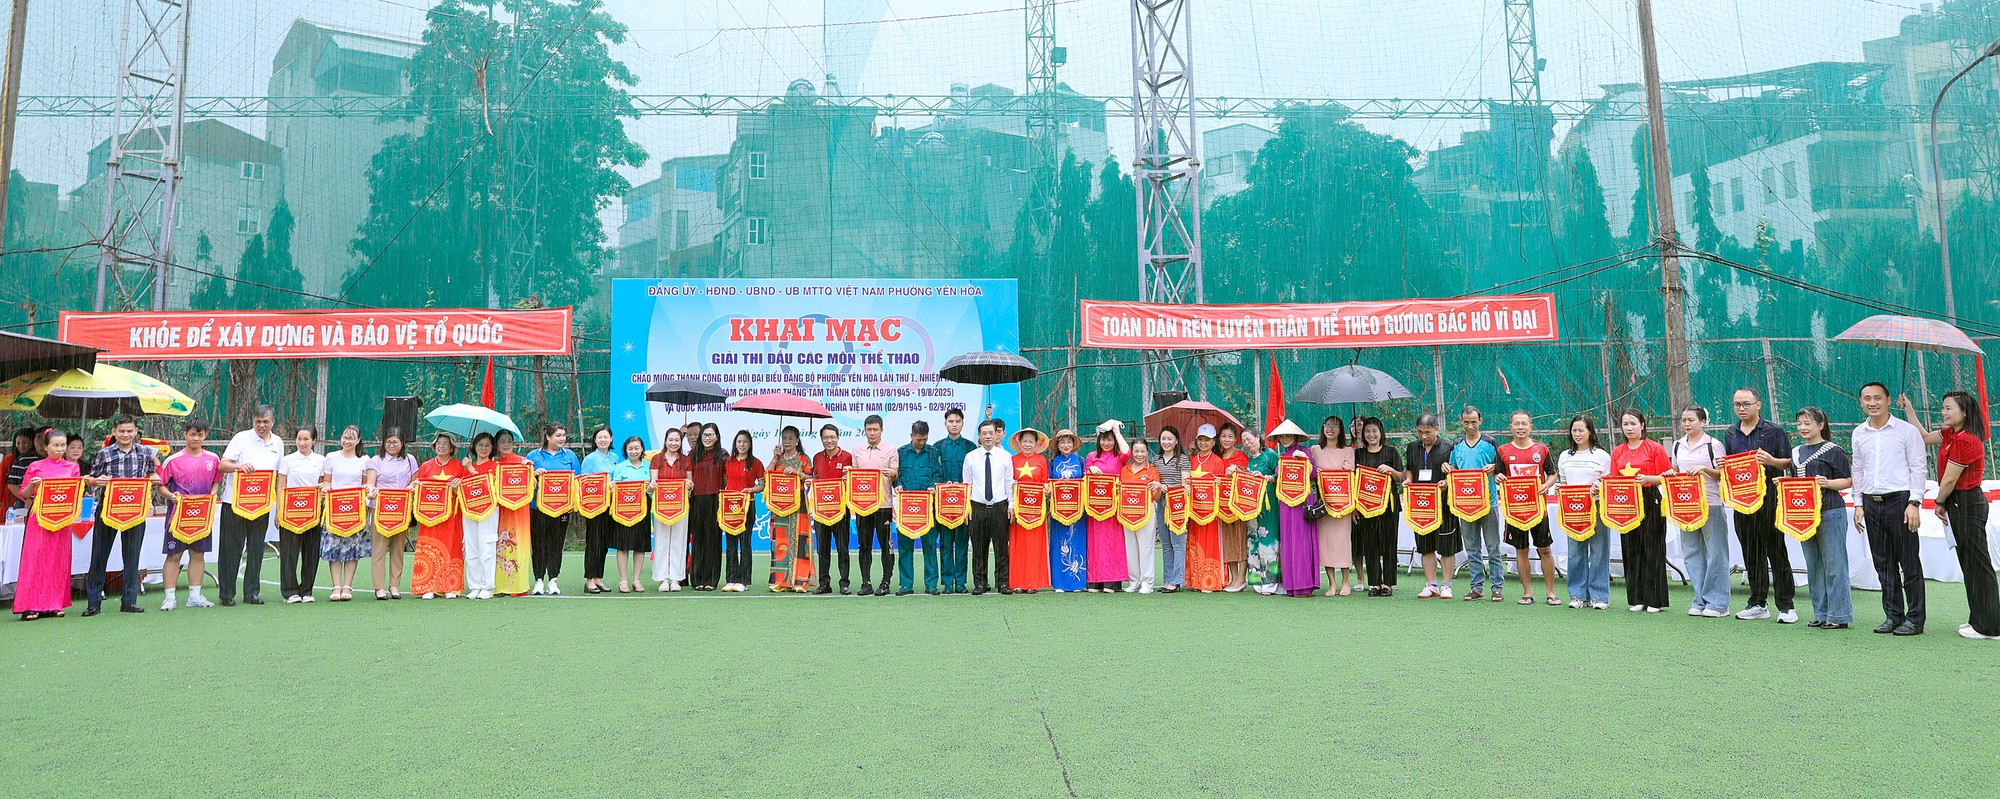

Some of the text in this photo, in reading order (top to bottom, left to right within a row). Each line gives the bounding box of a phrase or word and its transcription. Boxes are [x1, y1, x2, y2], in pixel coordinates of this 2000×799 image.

[648, 284, 678, 296] ĐẢNG
[682, 283, 696, 296] ỦY
[706, 286, 736, 296] HĐND
[746, 286, 776, 296] UBND
[786, 286, 800, 296] UB
[804, 286, 832, 296] MTTQ
[836, 285, 858, 297] VIỆT
[862, 286, 884, 296] NAM
[888, 284, 932, 296] PHƯỜNG
[936, 285, 956, 296] YÊN
[960, 284, 982, 296] HÒA
[1101, 304, 1538, 342] TOÀN DÂN RÈN LUYỆN THÂN THỂ THEO GƯƠNG BÁC HỒ VĨ ĐẠI
[129, 316, 504, 351] KHỎE ĐỂ XÂY DỰNG VÀ BẢO VỆ TỔ QUỐC
[730, 318, 901, 347] KHAI MẠC
[712, 350, 920, 365] GIẢI THI ĐẤU CÁC MÔN THỂ THAO
[632, 371, 652, 383] CHÀO
[702, 371, 722, 383] CÔNG
[724, 373, 736, 384] ĐẠI
[738, 372, 750, 384] HỘI
[751, 373, 764, 384] ĐẠI
[766, 371, 782, 383] BIỂU
[784, 371, 804, 383] ĐẢNG
[806, 372, 816, 384] BỘ
[817, 372, 846, 383] PHƯỜNG
[848, 372, 862, 383] YÊN
[864, 372, 878, 383] HÒA
[896, 372, 910, 383] THỨ
[826, 387, 849, 397] THÀNH
[851, 387, 870, 397] CÔNG
[873, 388, 910, 398] (19/8/1945
[917, 388, 954, 398] 19/8/2025)
[849, 402, 864, 413] VIỆT
[866, 403, 882, 412] NAM
[884, 402, 922, 412] (02/9/1945
[928, 402, 966, 412] 02/9/2025)
